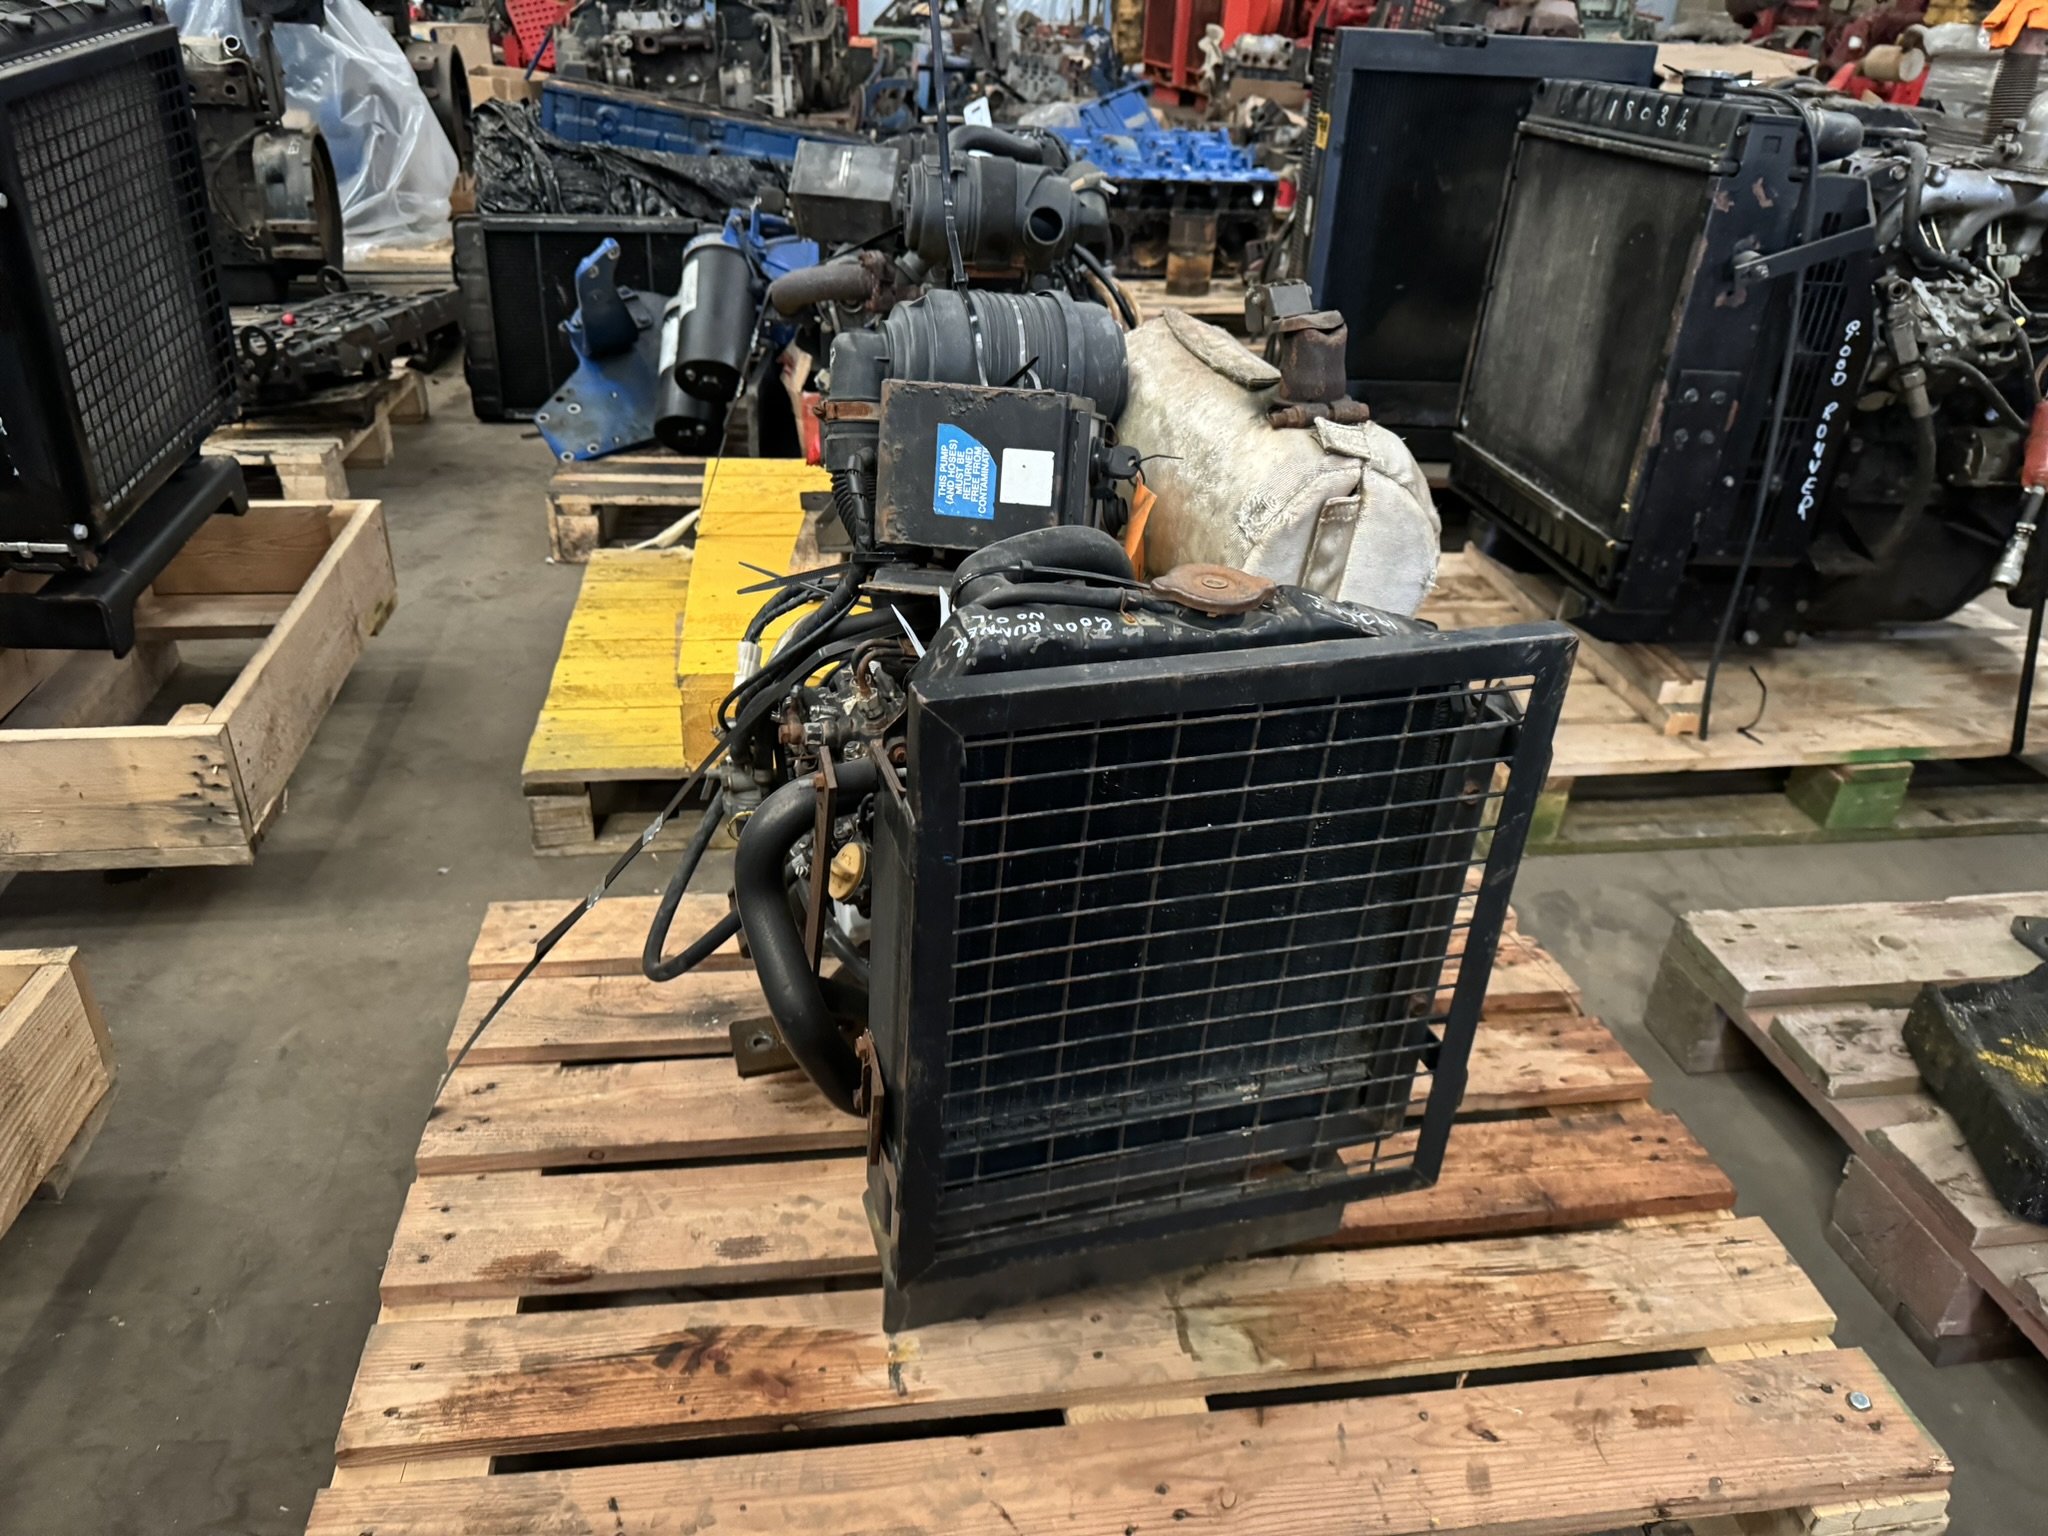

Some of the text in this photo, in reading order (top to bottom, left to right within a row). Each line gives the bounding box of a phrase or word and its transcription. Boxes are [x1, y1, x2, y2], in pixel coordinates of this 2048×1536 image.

[1607, 99, 1690, 135] 18034
[938, 444, 949, 497] THIS PUMP
[945, 439, 959, 505] (AND HOSES)
[955, 450, 965, 495] MUST BE
[962, 447, 974, 500] RETURNED
[971, 446, 983, 503] FREE FROM
[1053, 616, 1112, 632] GOOD
